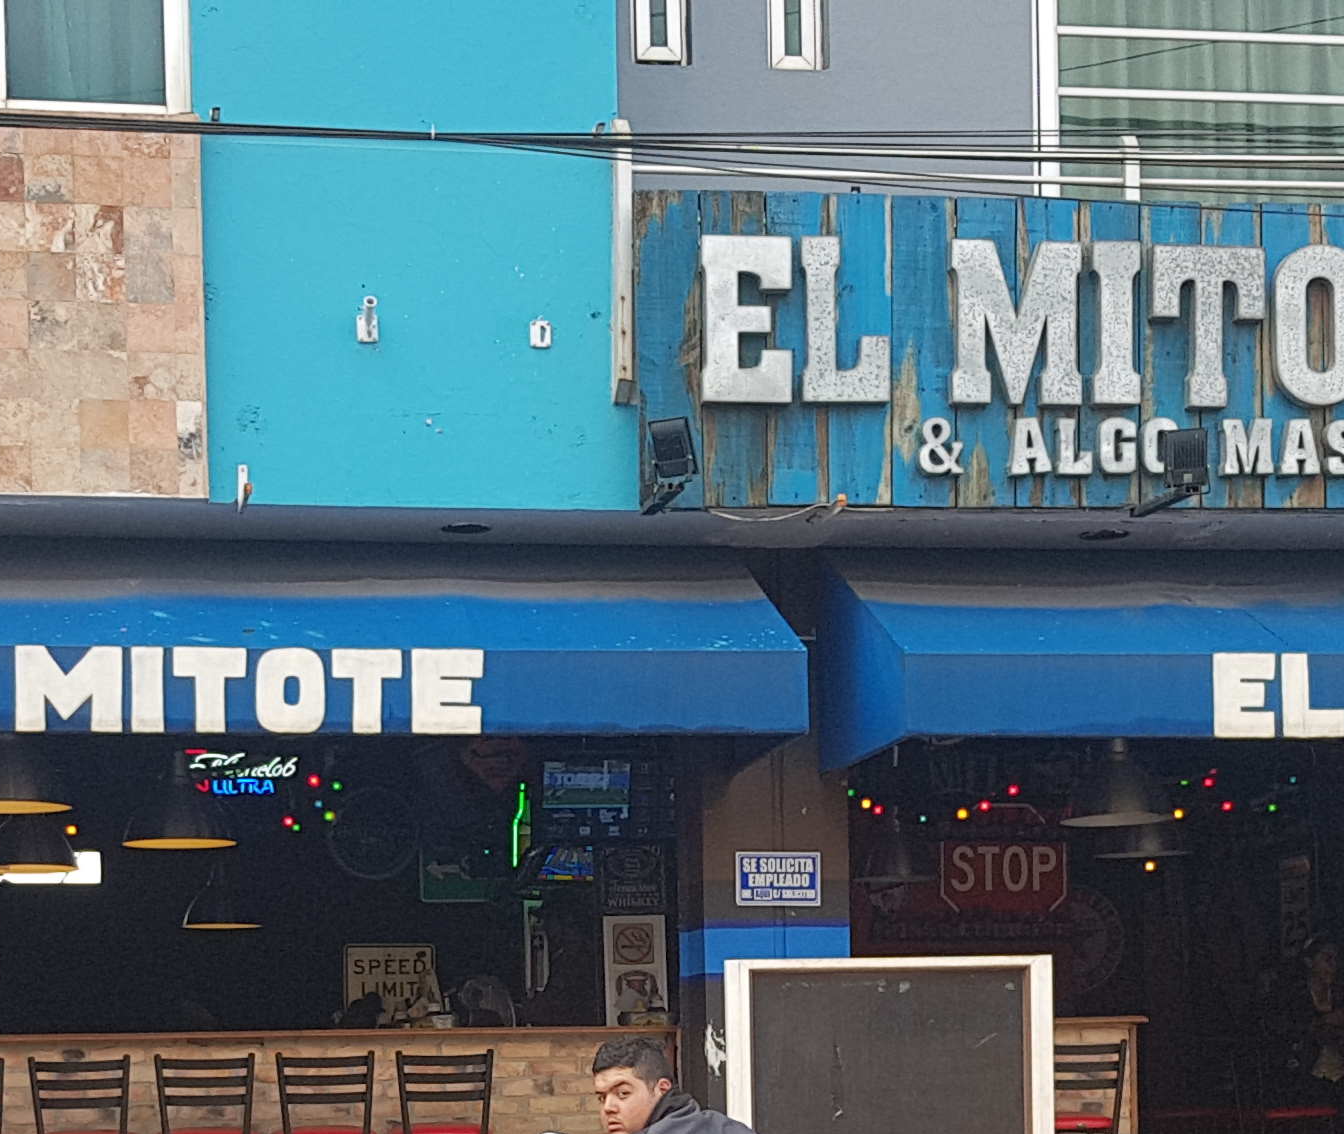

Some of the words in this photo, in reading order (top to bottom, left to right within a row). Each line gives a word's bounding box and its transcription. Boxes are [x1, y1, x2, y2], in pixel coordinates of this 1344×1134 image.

[700, 235, 891, 403] EL
[919, 417, 964, 476] &
[14, 645, 484, 734] MITOTE
[742, 858, 757, 873] SE
[759, 858, 814, 873] SOLICITA
[748, 873, 810, 887] EMPLEADO
[951, 845, 1057, 892] STOP
[353, 959, 426, 975] SPEED
